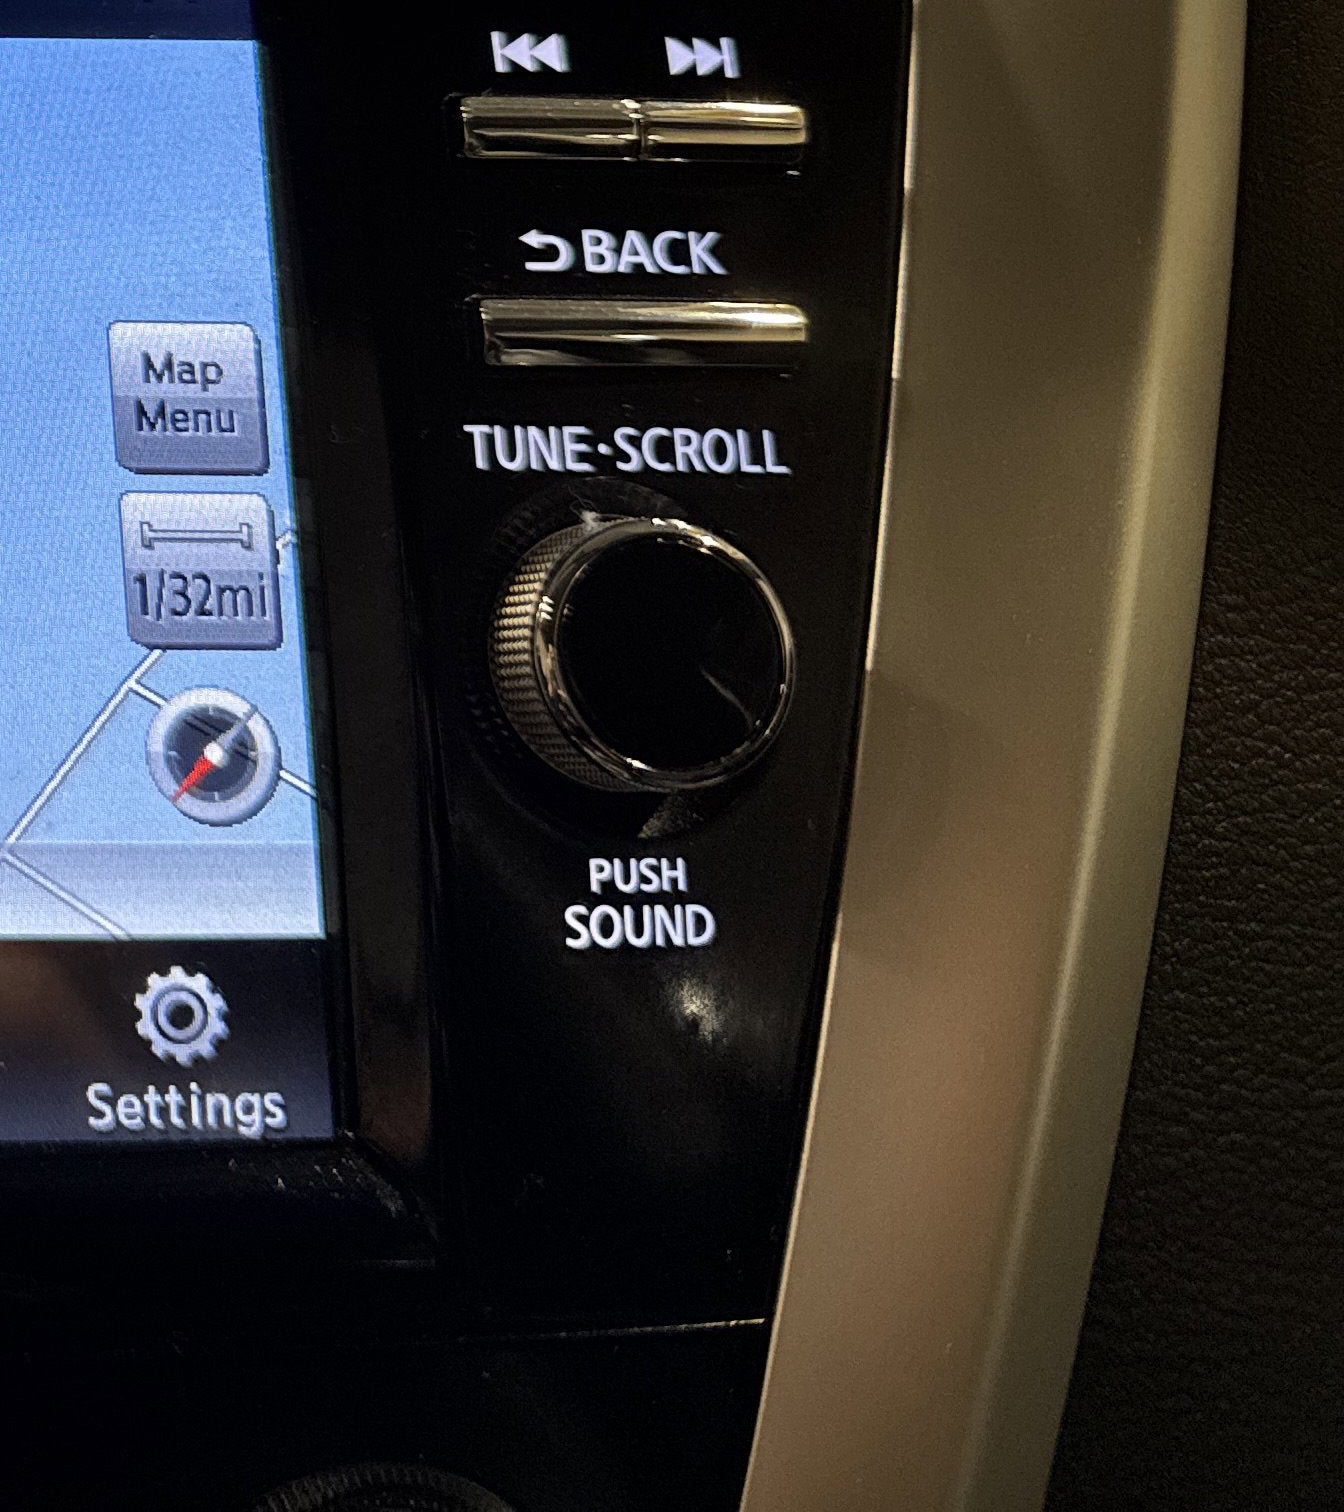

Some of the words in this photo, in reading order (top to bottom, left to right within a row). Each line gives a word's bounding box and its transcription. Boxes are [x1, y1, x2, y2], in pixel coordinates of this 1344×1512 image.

[580, 227, 730, 276] BACK
[140, 351, 224, 390] Map
[134, 397, 236, 434] Menu
[131, 570, 269, 622] 1/32mi
[587, 856, 689, 895] PUSH
[563, 902, 717, 951] SOUND
[85, 1082, 288, 1139] Settings
